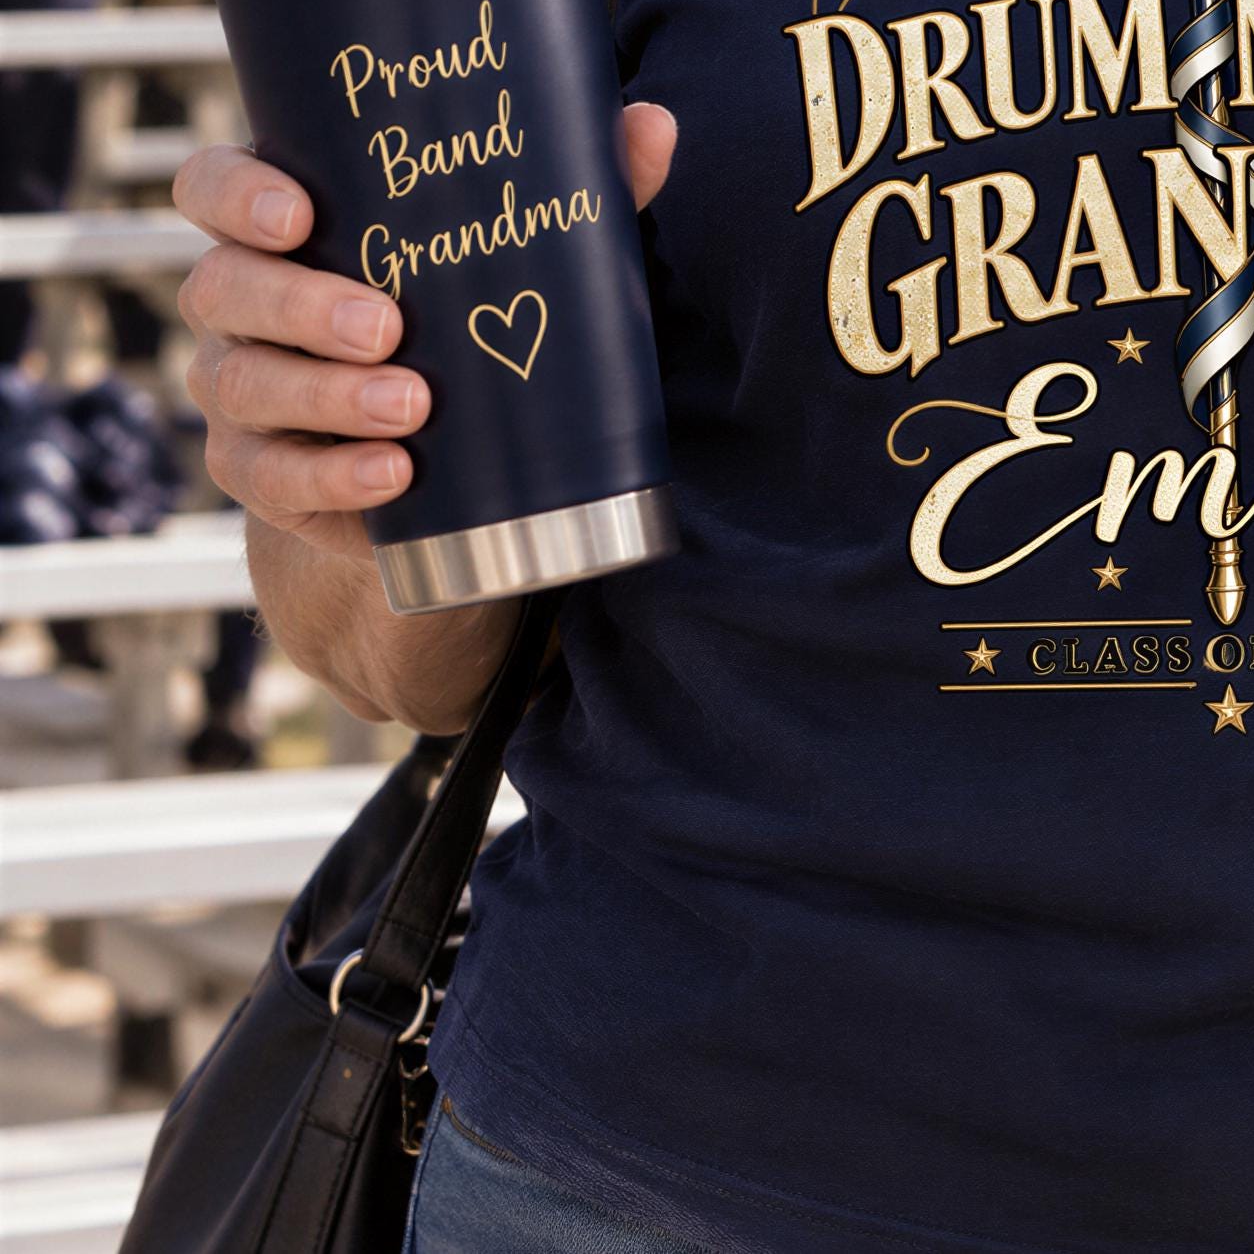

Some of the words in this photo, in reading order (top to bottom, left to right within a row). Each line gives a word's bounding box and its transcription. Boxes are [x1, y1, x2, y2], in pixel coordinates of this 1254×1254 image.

[330, 0, 508, 119] Proud
[368, 89, 524, 200] Band
[360, 180, 602, 301] Grandma
[1028, 636, 1193, 675] CLASS
